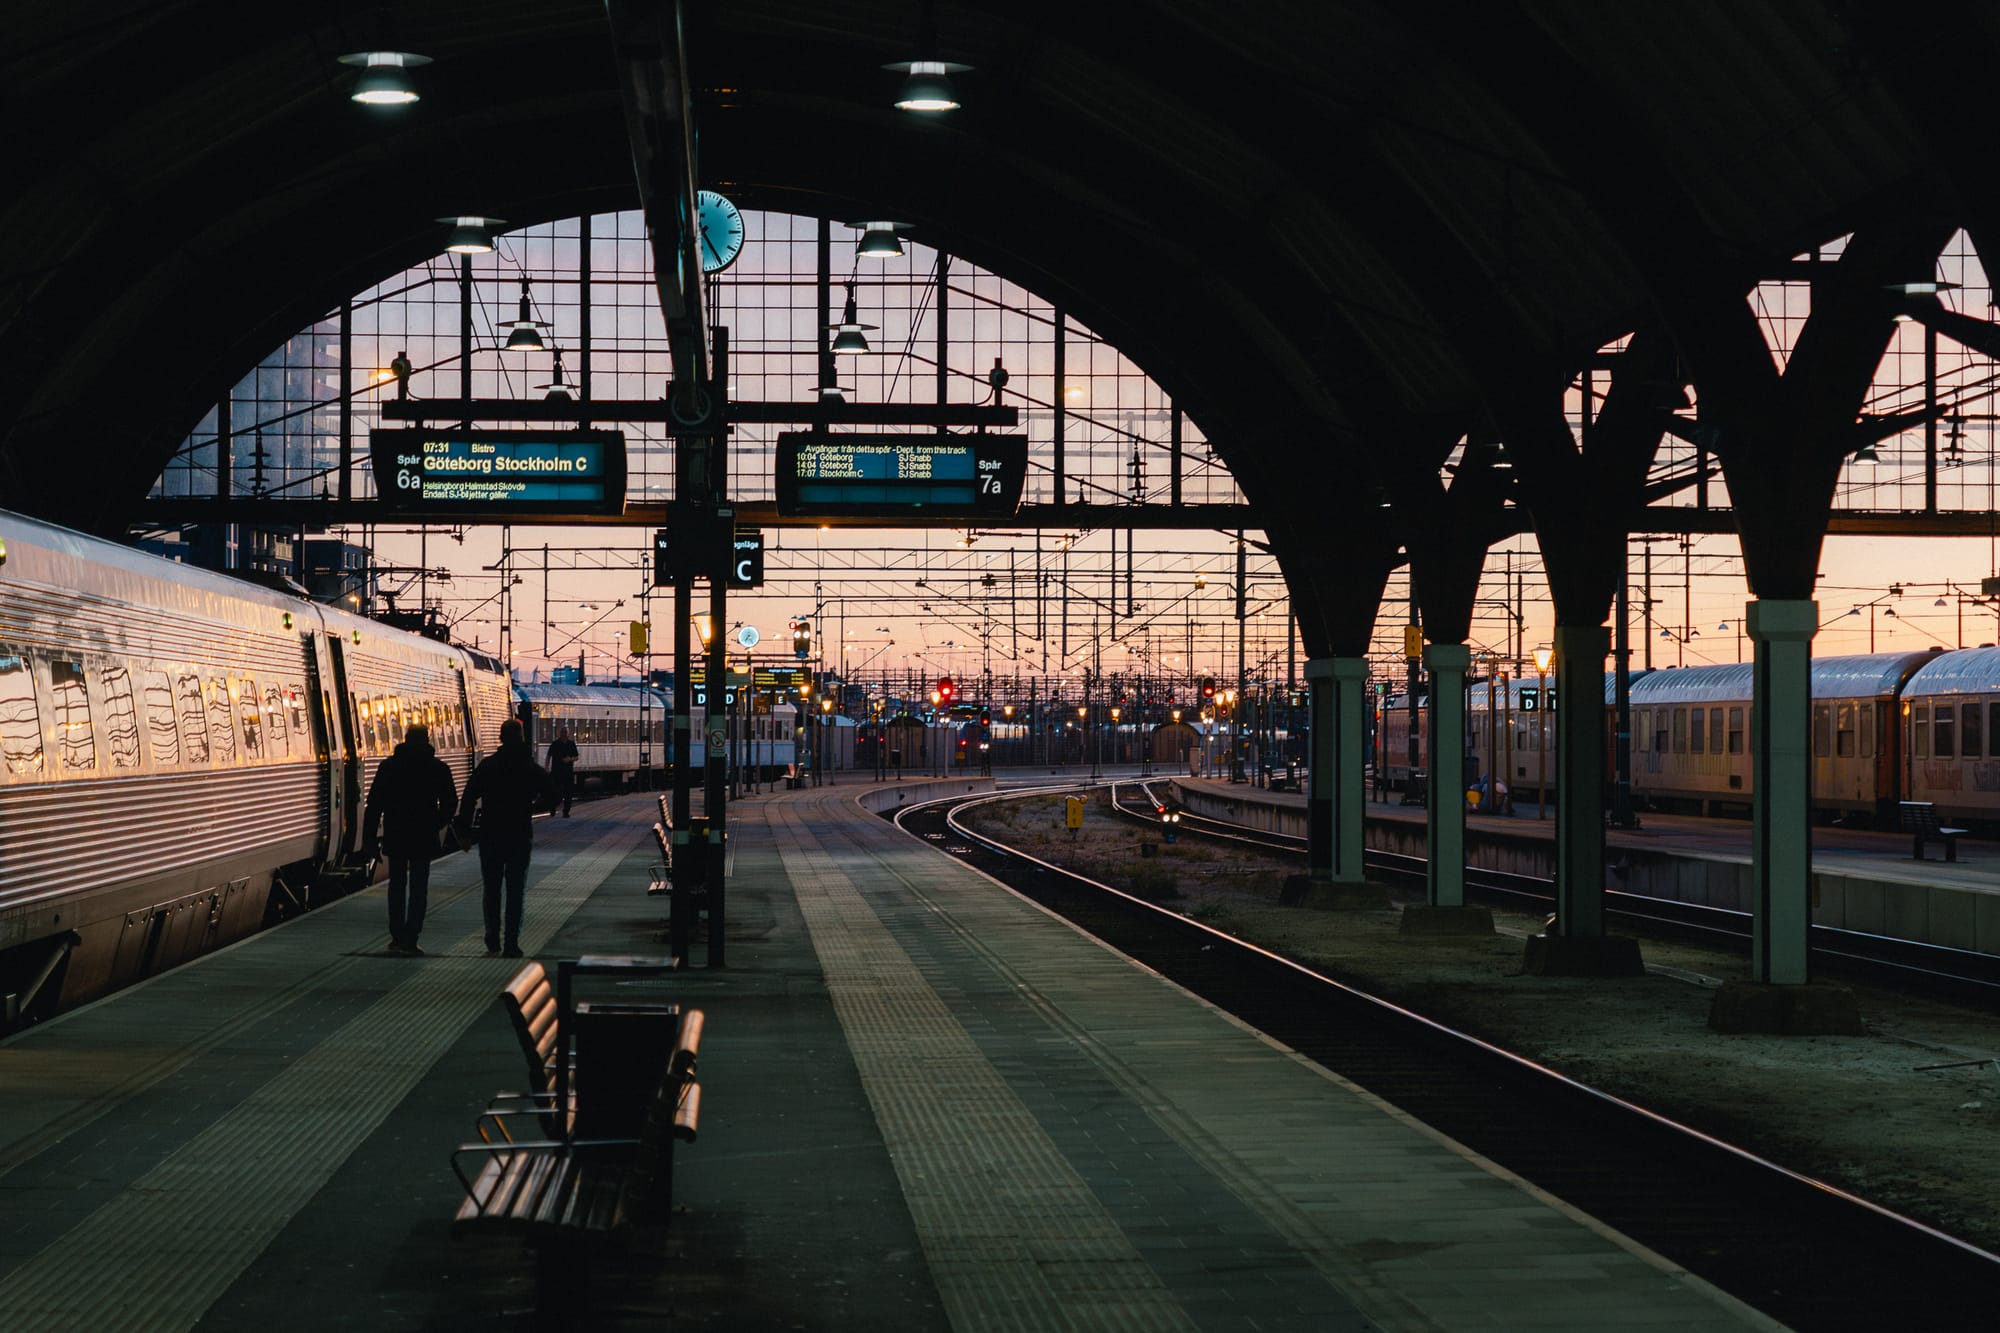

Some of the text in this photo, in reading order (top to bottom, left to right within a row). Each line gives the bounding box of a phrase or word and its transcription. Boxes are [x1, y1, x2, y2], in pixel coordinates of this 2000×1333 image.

[423, 442, 496, 453] 07:31 Bistro
[805, 444, 840, 454] Avgångar
[841, 444, 856, 453] från
[856, 445, 875, 453] detta
[875, 445, 891, 455] spår
[917, 446, 933, 454] from
[934, 446, 947, 454] this
[947, 446, 966, 454] track
[397, 454, 421, 466] Spår
[797, 452, 932, 462] 10:04 Göteborg SJ Snabb
[423, 456, 587, 474] Göteborg Stockholm C
[797, 461, 932, 470] 14:04 Göteborg SJ Snabb
[978, 460, 1001, 471] Spår
[397, 469, 420, 489] 6a
[797, 469, 932, 478] 17:07 Stockholm C SJ Snabb
[423, 481, 526, 491] Helsingborg Halmstad Skövde
[980, 475, 1001, 494] 7a
[423, 490, 448, 499] Endast
[449, 490, 488, 500] SJ-biljetter
[737, 560, 752, 581] C
[698, 693, 706, 704] D
[725, 693, 734, 704] D
[778, 696, 784, 704] E
[1525, 699, 1534, 710] D
